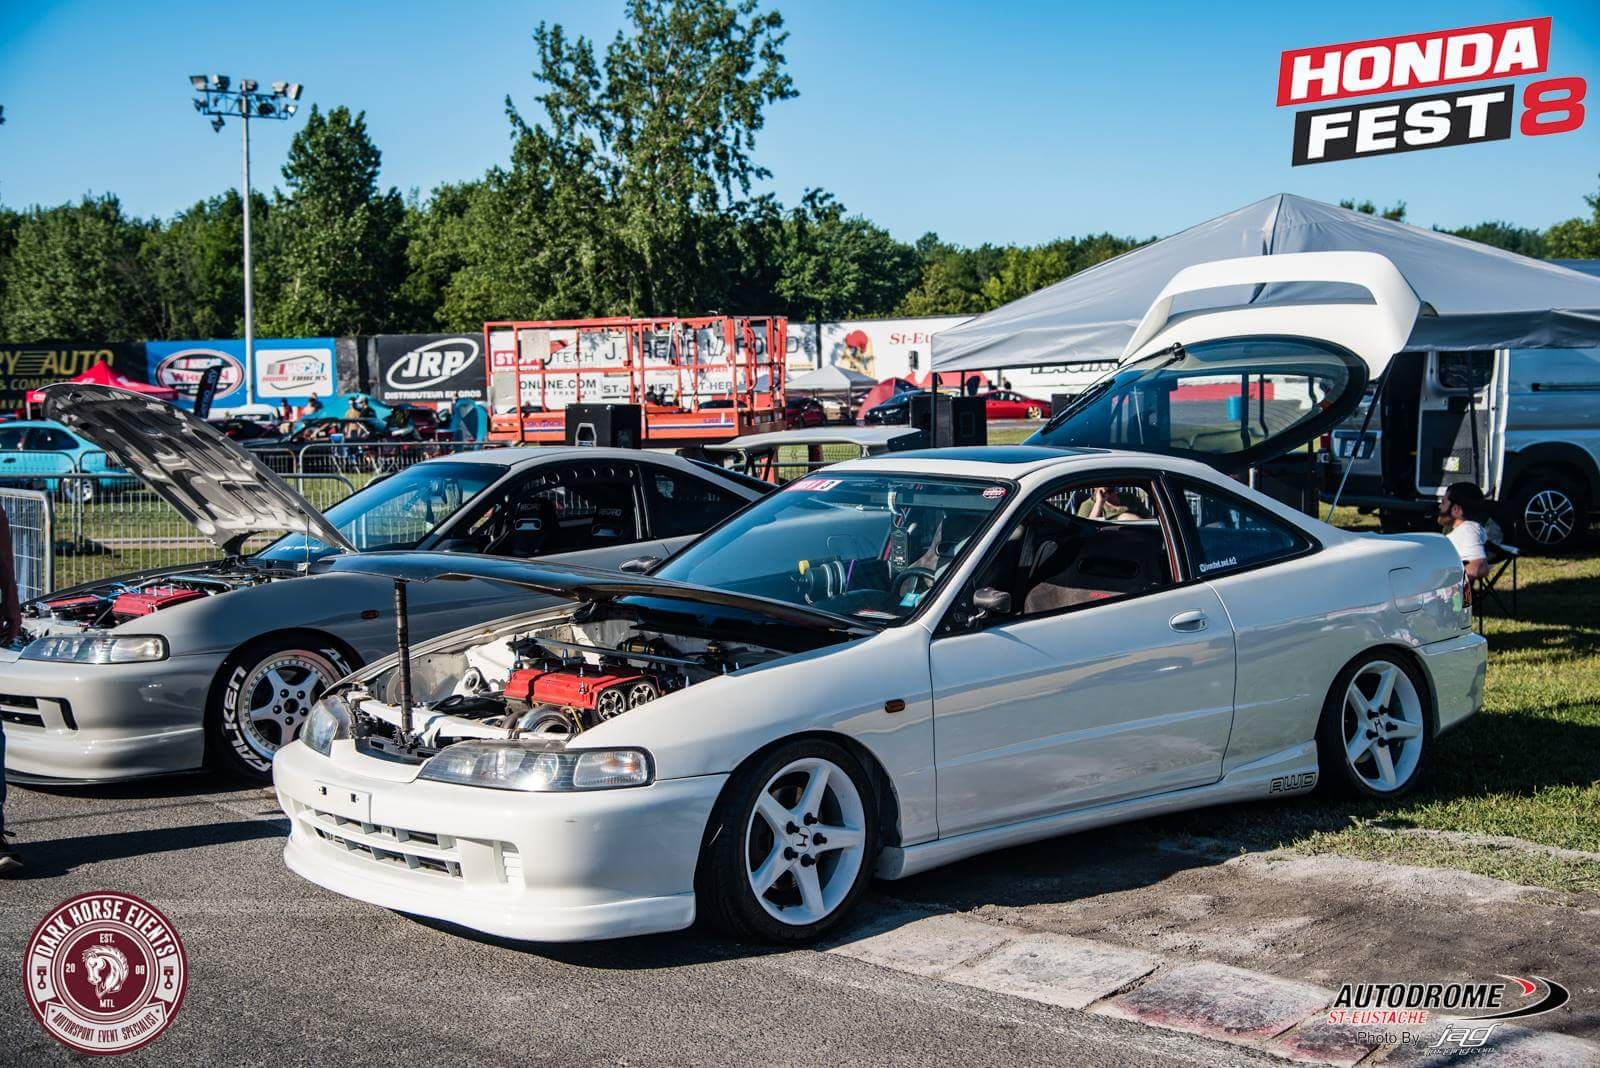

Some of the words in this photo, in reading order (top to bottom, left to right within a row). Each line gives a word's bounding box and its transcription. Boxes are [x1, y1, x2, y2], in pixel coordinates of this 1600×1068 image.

[39, 349, 115, 376] AUTO
[401, 350, 465, 378] JRP
[384, 391, 442, 400] DISTRIBUTEUR
[459, 390, 481, 398] GROS
[223, 666, 273, 772] FALKEN
[1269, 772, 1317, 793] AWD
